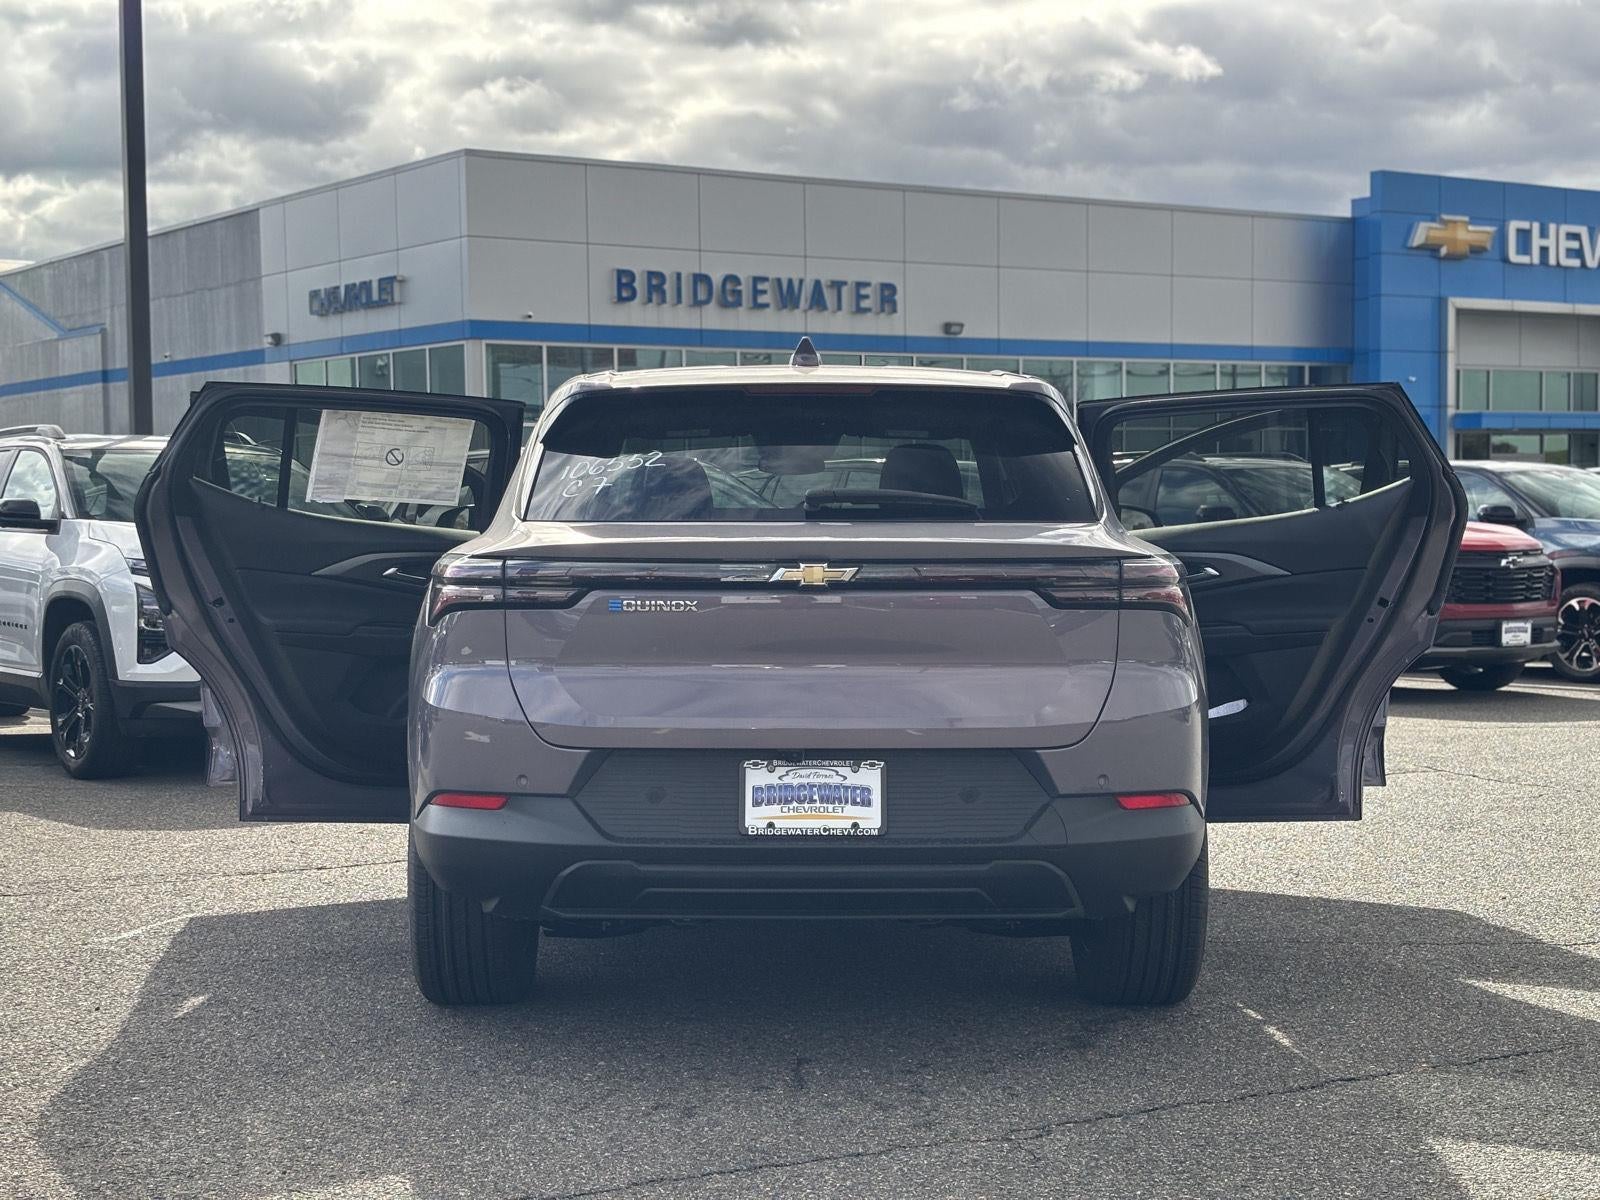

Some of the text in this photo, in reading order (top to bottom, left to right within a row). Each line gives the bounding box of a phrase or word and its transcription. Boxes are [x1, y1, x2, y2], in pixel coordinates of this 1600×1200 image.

[613, 268, 899, 315] BRIDGEWATER
[560, 450, 666, 480] 106552
[607, 598, 699, 613] EQUINOX
[752, 782, 873, 808] BRIDGEWATER
